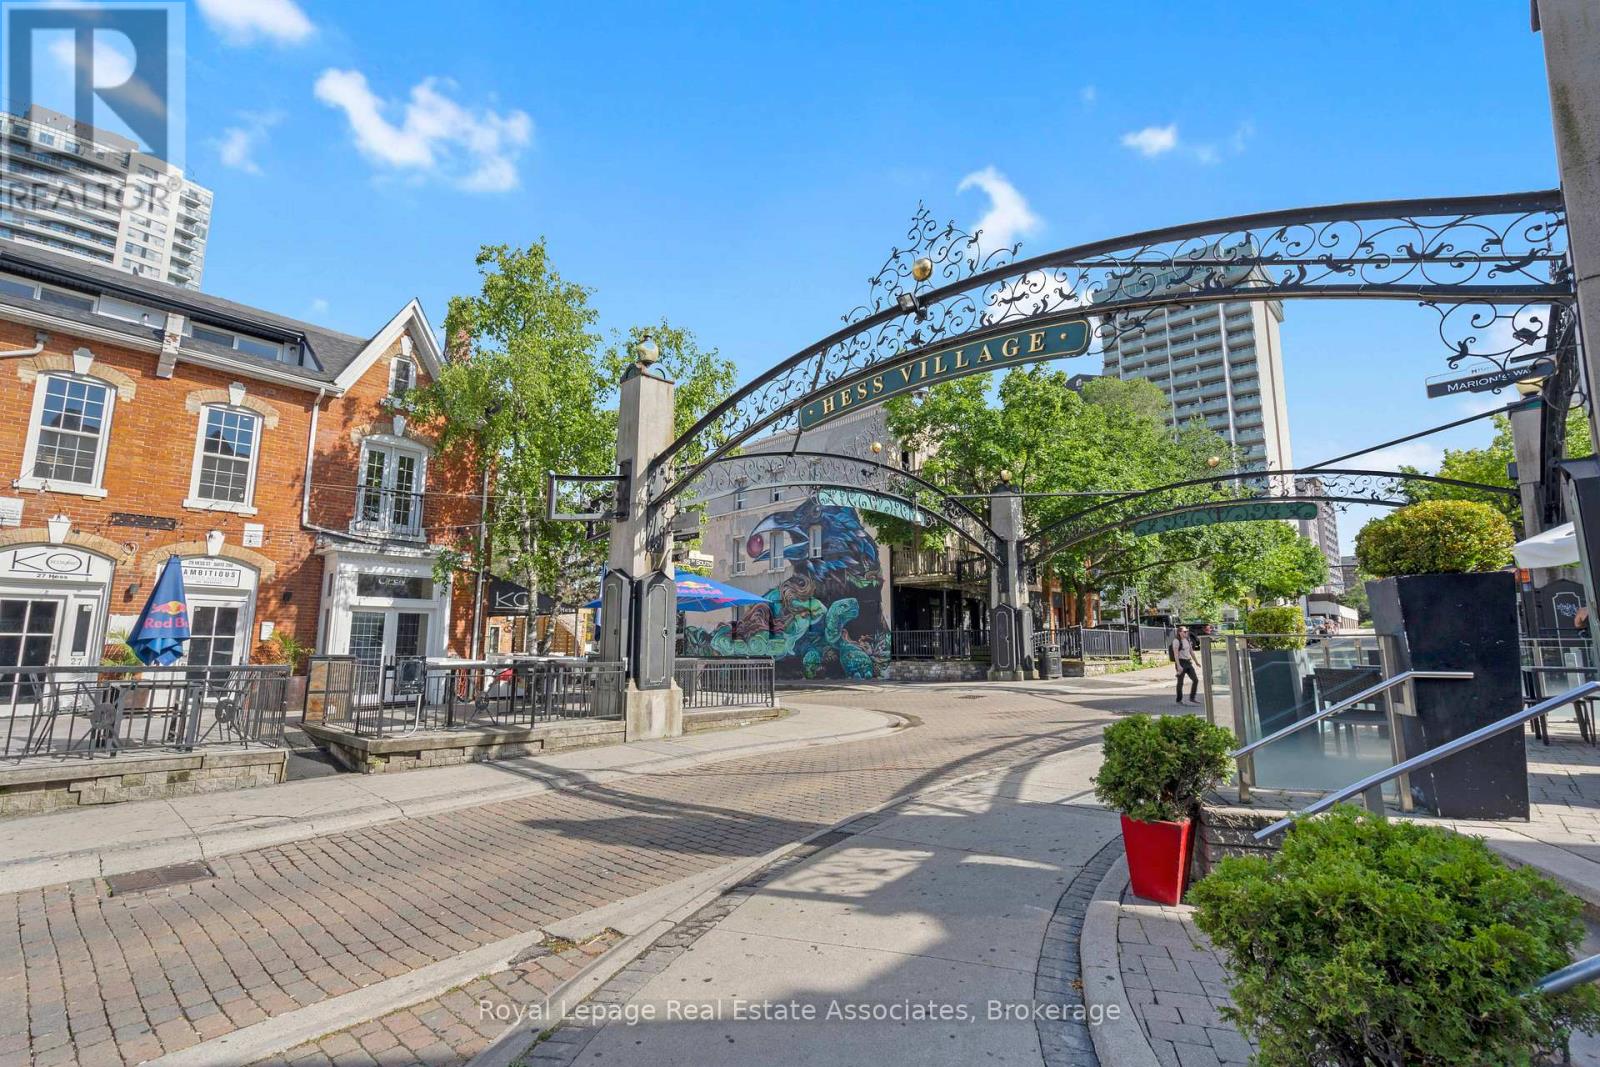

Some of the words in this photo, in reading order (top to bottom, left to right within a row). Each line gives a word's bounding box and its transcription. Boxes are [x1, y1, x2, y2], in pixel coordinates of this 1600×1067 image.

[822, 377, 884, 415] HESS
[901, 331, 1046, 384] VILLAGE
[12, 551, 92, 574] KOI
[183, 568, 236, 578] AMBITIOUS
[144, 617, 172, 628] Red
